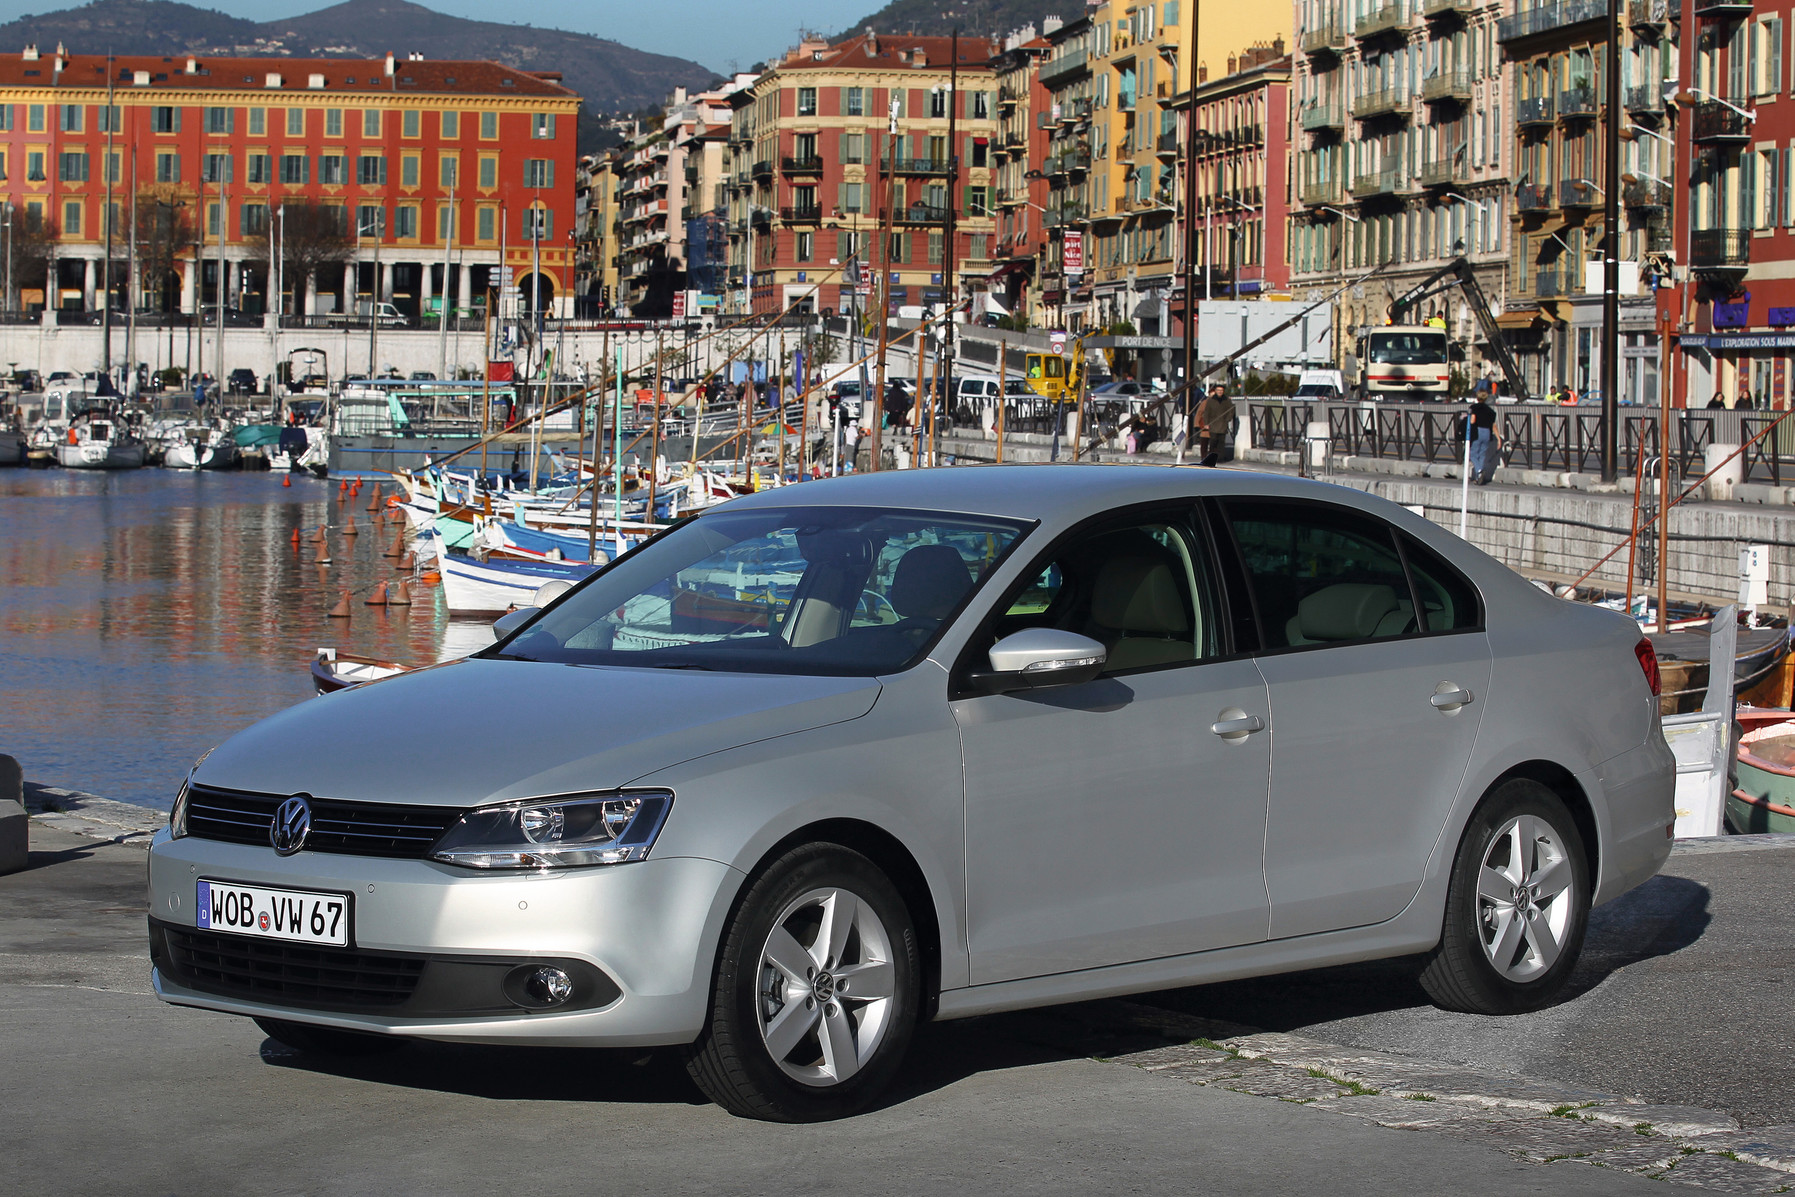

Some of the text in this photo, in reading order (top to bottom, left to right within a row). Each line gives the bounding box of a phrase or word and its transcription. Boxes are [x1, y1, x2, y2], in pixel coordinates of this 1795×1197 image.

[1122, 336, 1172, 347] PORT DE NICE
[1761, 336, 1776, 347] SOUS
[201, 909, 207, 920] D
[211, 888, 343, 938] WOB VW 67
